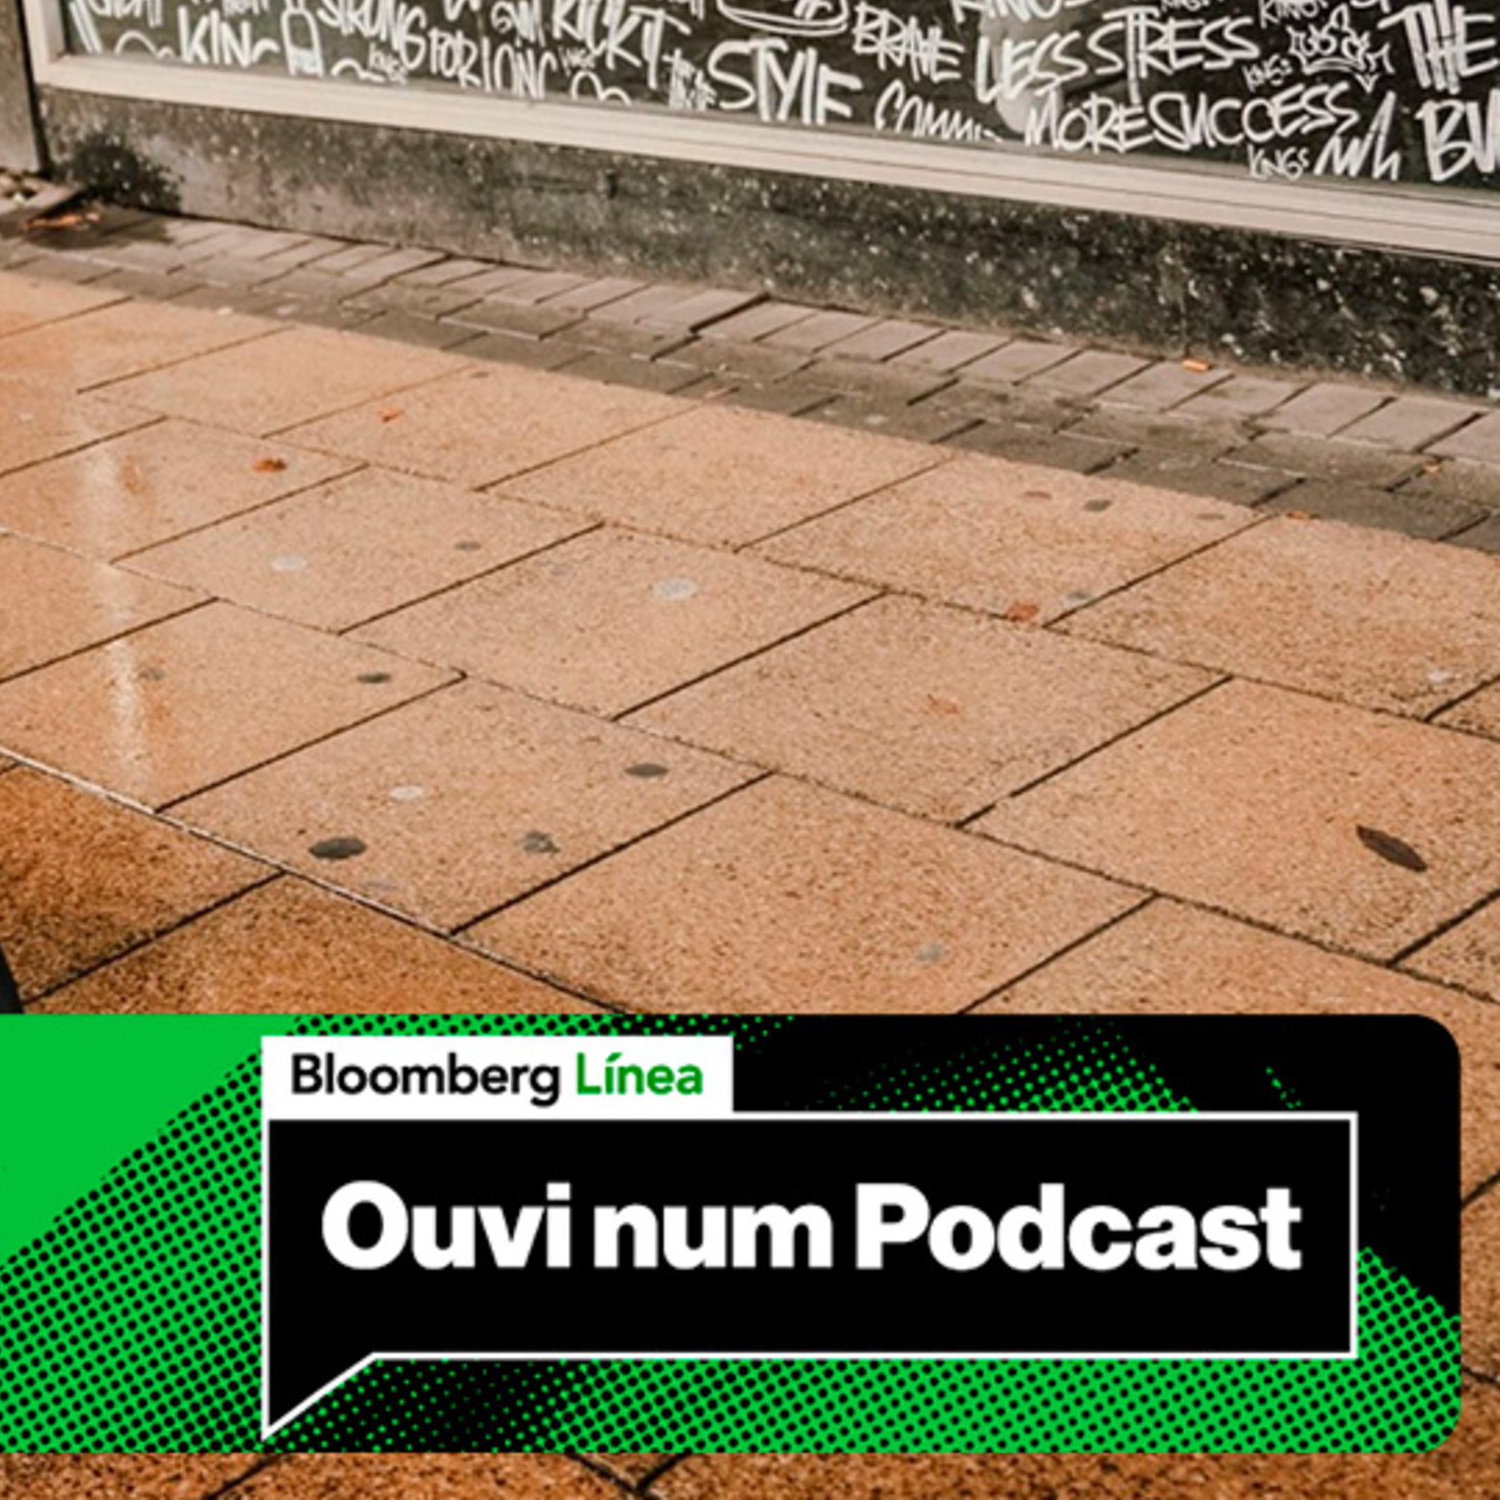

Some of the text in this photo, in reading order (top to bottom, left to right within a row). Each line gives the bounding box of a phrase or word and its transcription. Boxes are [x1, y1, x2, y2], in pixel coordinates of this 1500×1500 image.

[975, 29, 1089, 104] LESS
[1085, 5, 1261, 107] STRESS
[1150, 80, 1362, 151] SUCCESS
